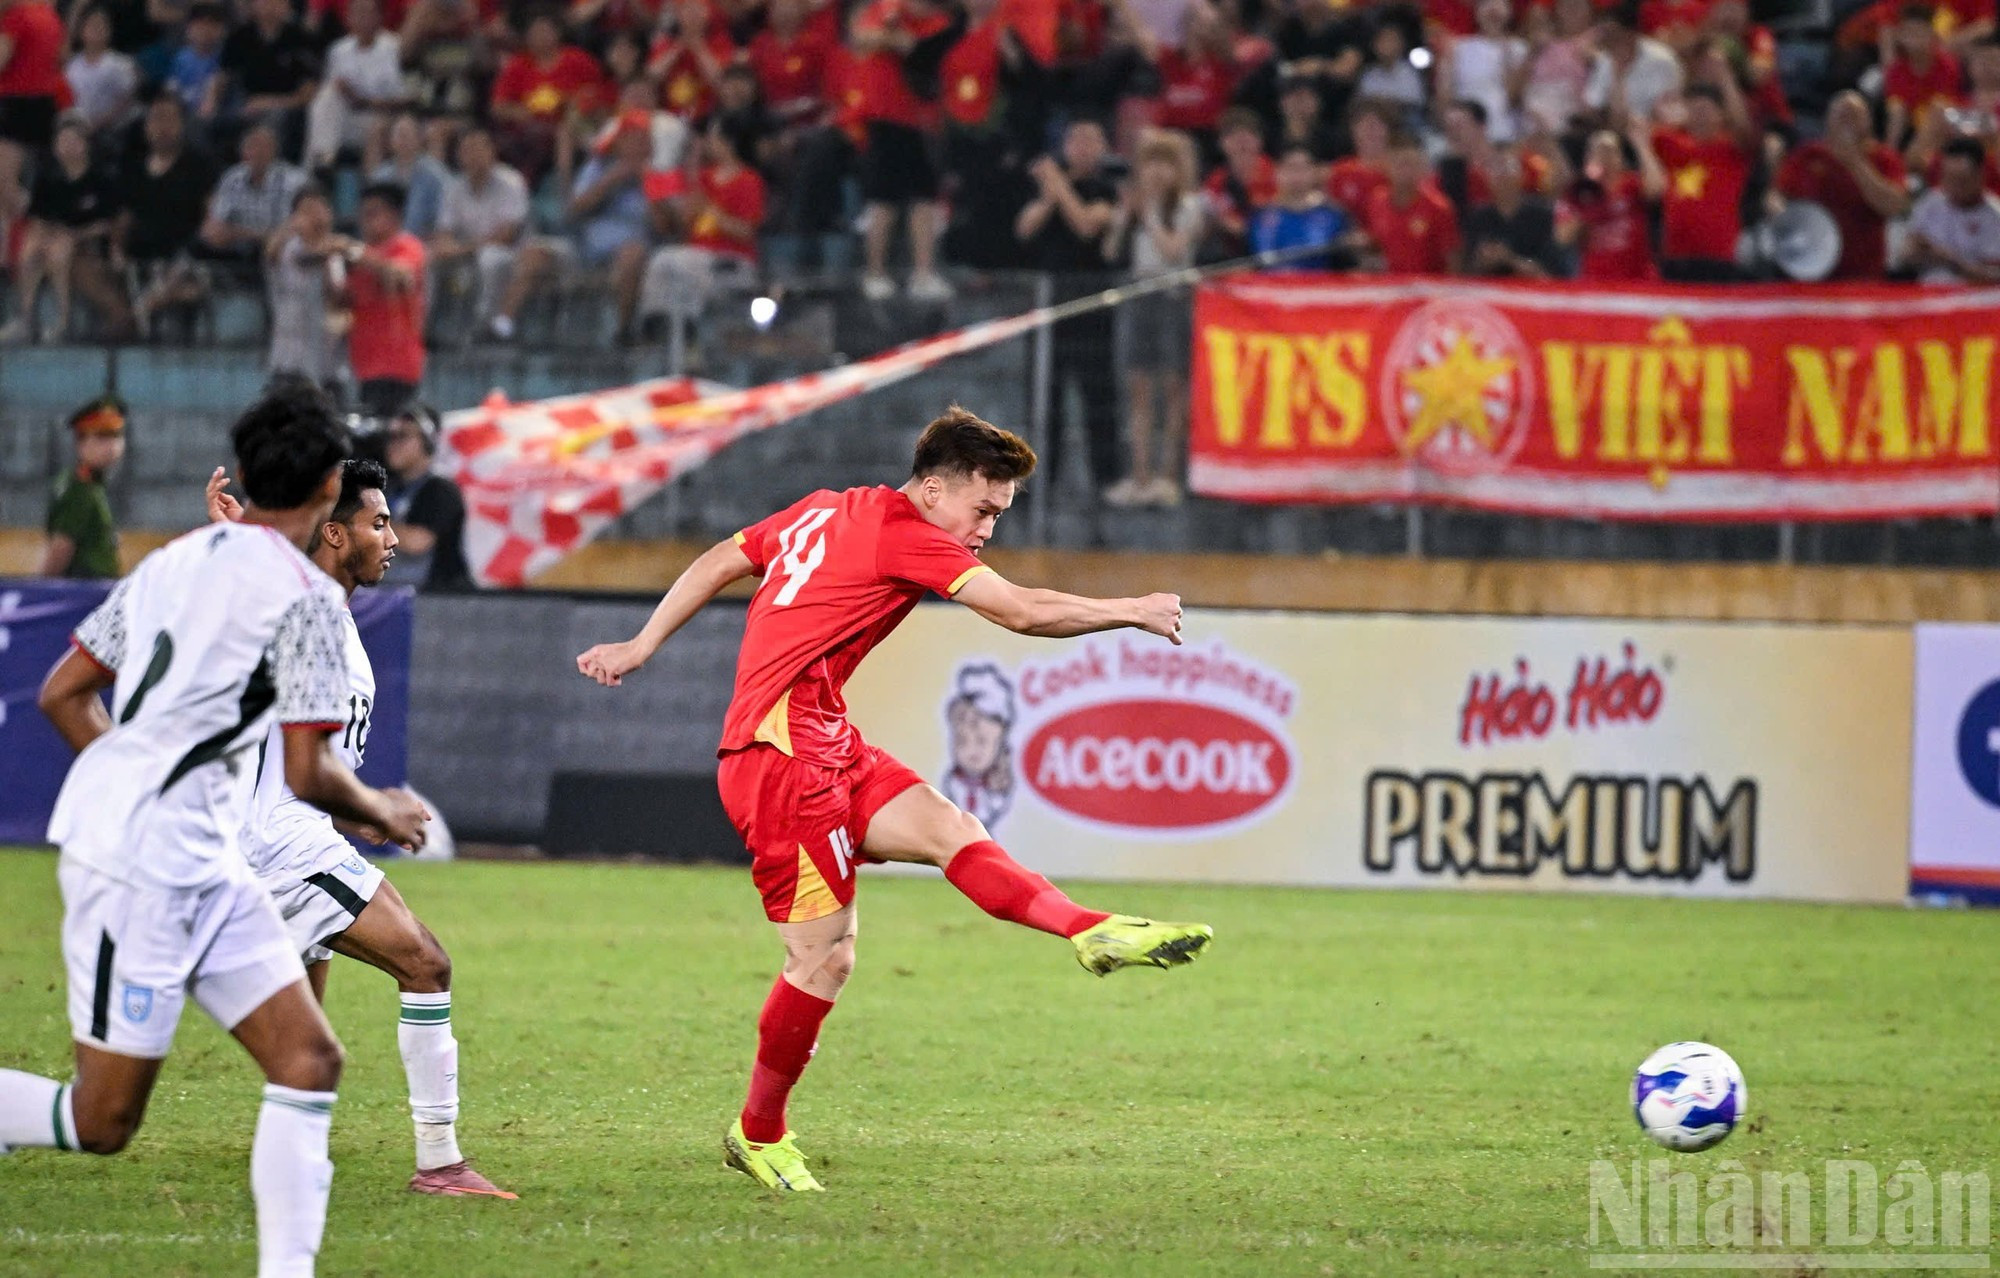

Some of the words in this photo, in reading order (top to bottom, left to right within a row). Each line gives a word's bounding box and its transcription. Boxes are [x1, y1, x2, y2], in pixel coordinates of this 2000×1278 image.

[1205, 326, 1371, 449] VFS
[1543, 314, 1753, 490] VIỆT
[1782, 337, 1996, 466] NAM
[760, 508, 838, 606] 14
[1021, 644, 1107, 706] Cook
[1118, 639, 1292, 716] happiness
[1365, 770, 1758, 882] PREMIUM
